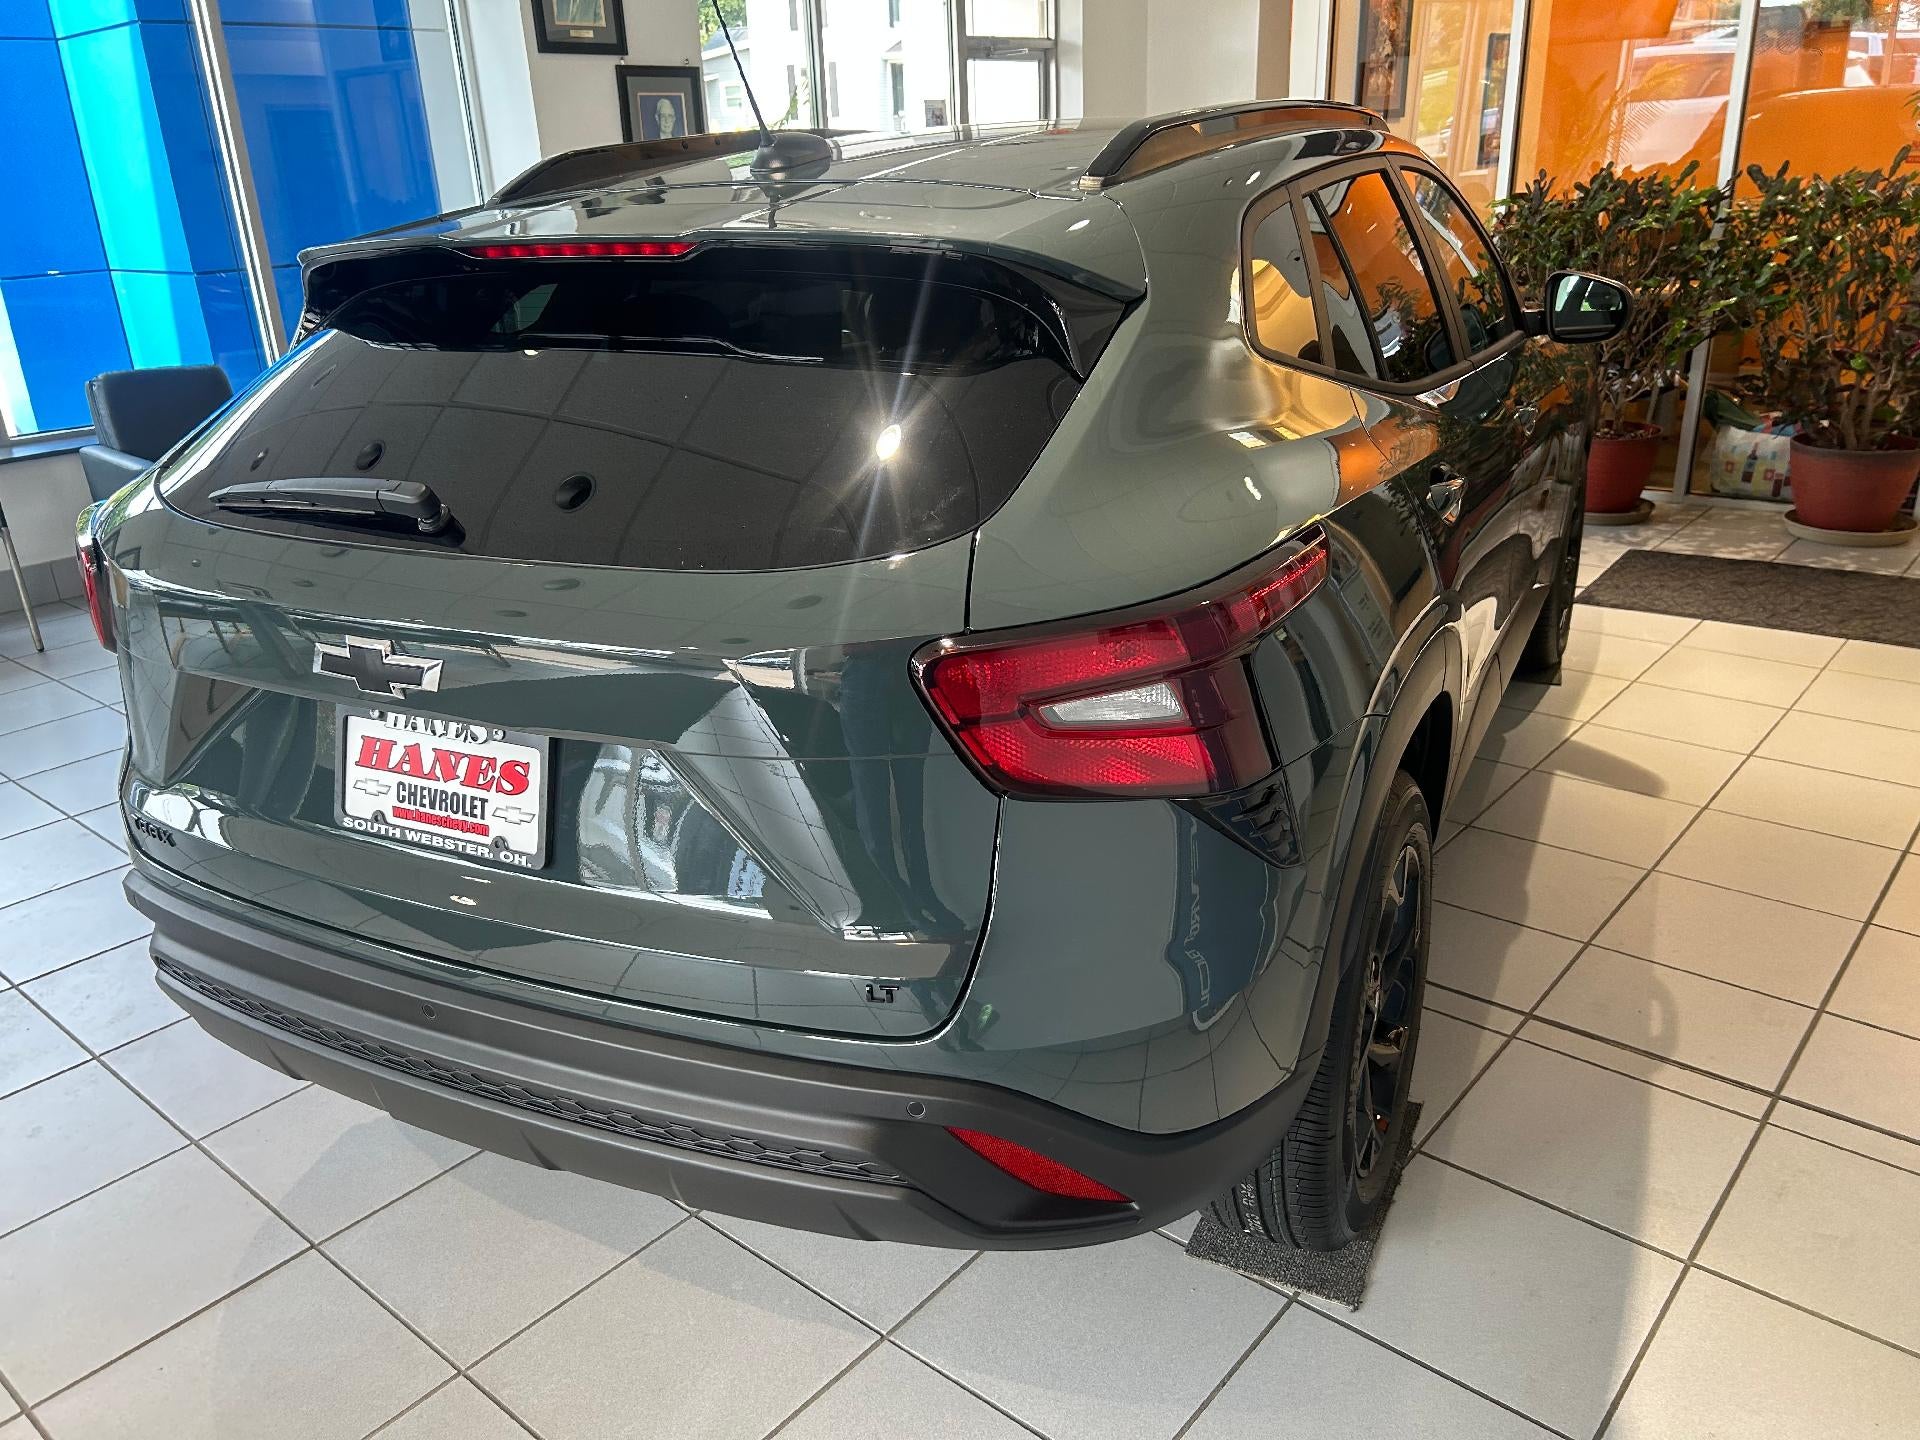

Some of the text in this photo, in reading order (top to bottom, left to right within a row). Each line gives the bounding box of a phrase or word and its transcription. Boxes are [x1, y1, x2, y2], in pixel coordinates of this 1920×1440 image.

[384, 711, 489, 745] HANES
[355, 735, 531, 796] HANES
[396, 780, 489, 821] CHEVROLET
[392, 805, 490, 837] www.haneschevy.com
[343, 816, 532, 869] SOUTH WEBSTER, OH.
[865, 983, 900, 1004] LT
